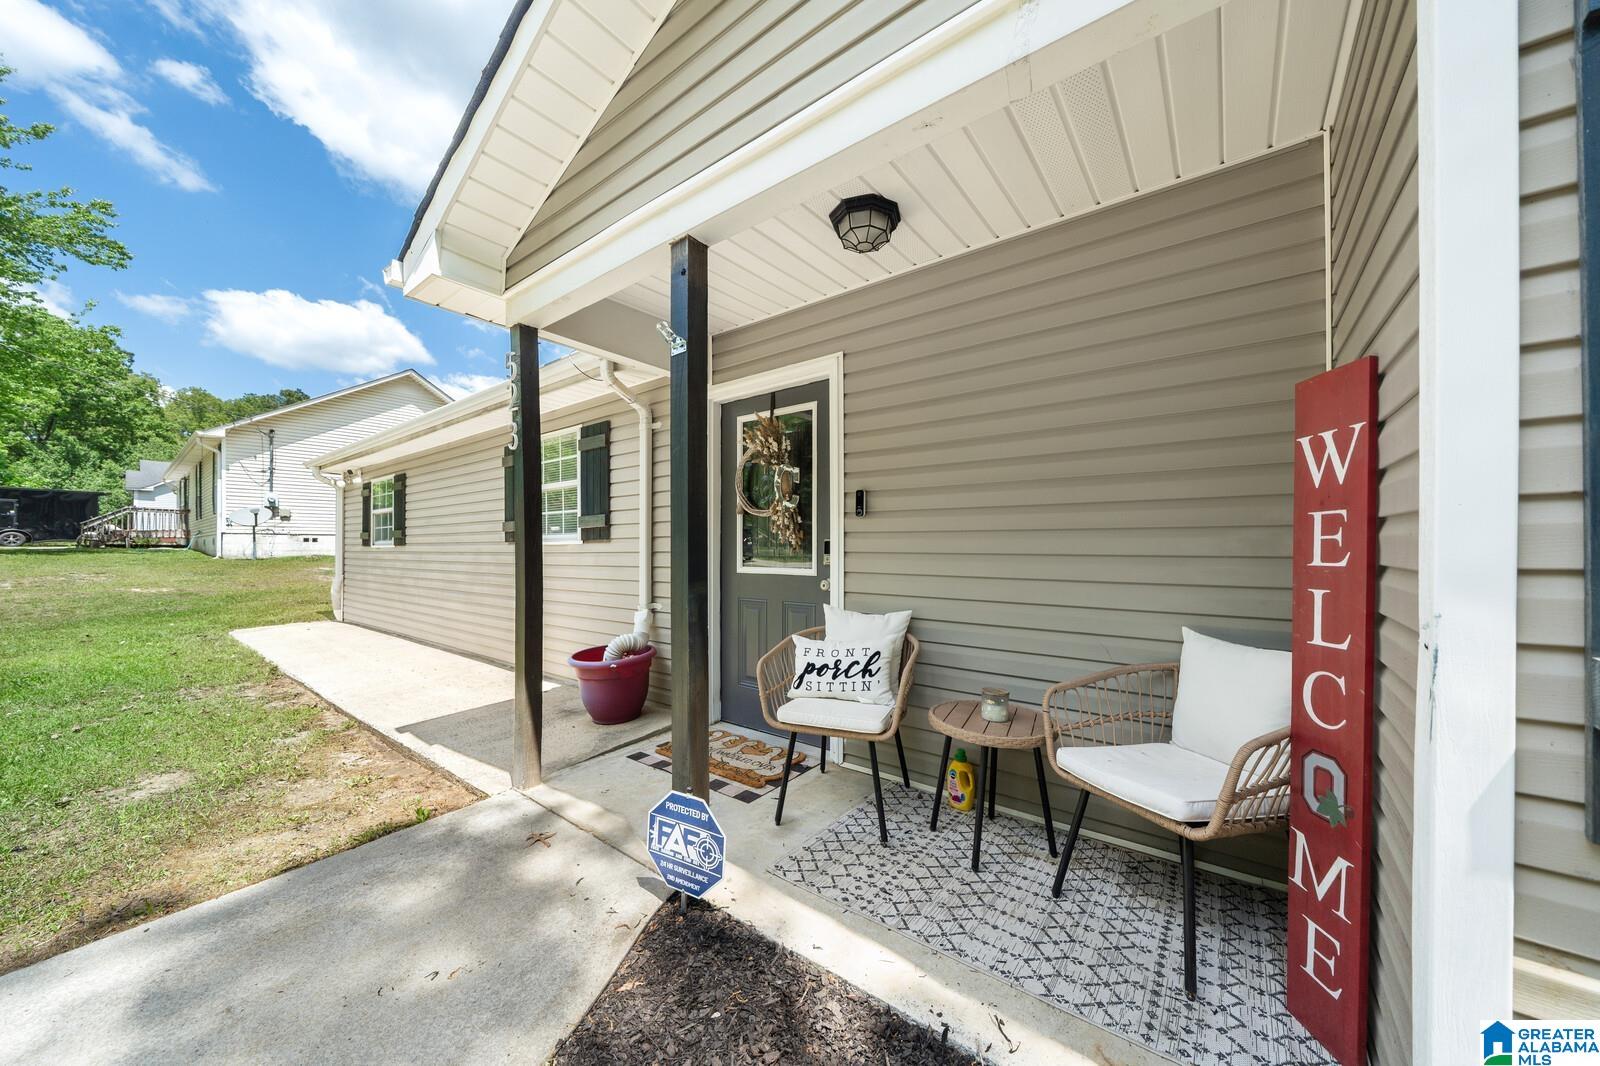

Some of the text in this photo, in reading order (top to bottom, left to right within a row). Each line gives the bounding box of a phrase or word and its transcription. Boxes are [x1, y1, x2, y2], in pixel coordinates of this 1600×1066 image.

[803, 647, 871, 658] FRONT
[793, 650, 882, 690] porch
[1288, 421, 1367, 1000] WELCOME
[665, 801, 710, 823] PROTECTED BY
[667, 862, 674, 870] HR
[673, 864, 710, 884] SURVEILLANCE
[675, 876, 701, 891] AMENDMENT
